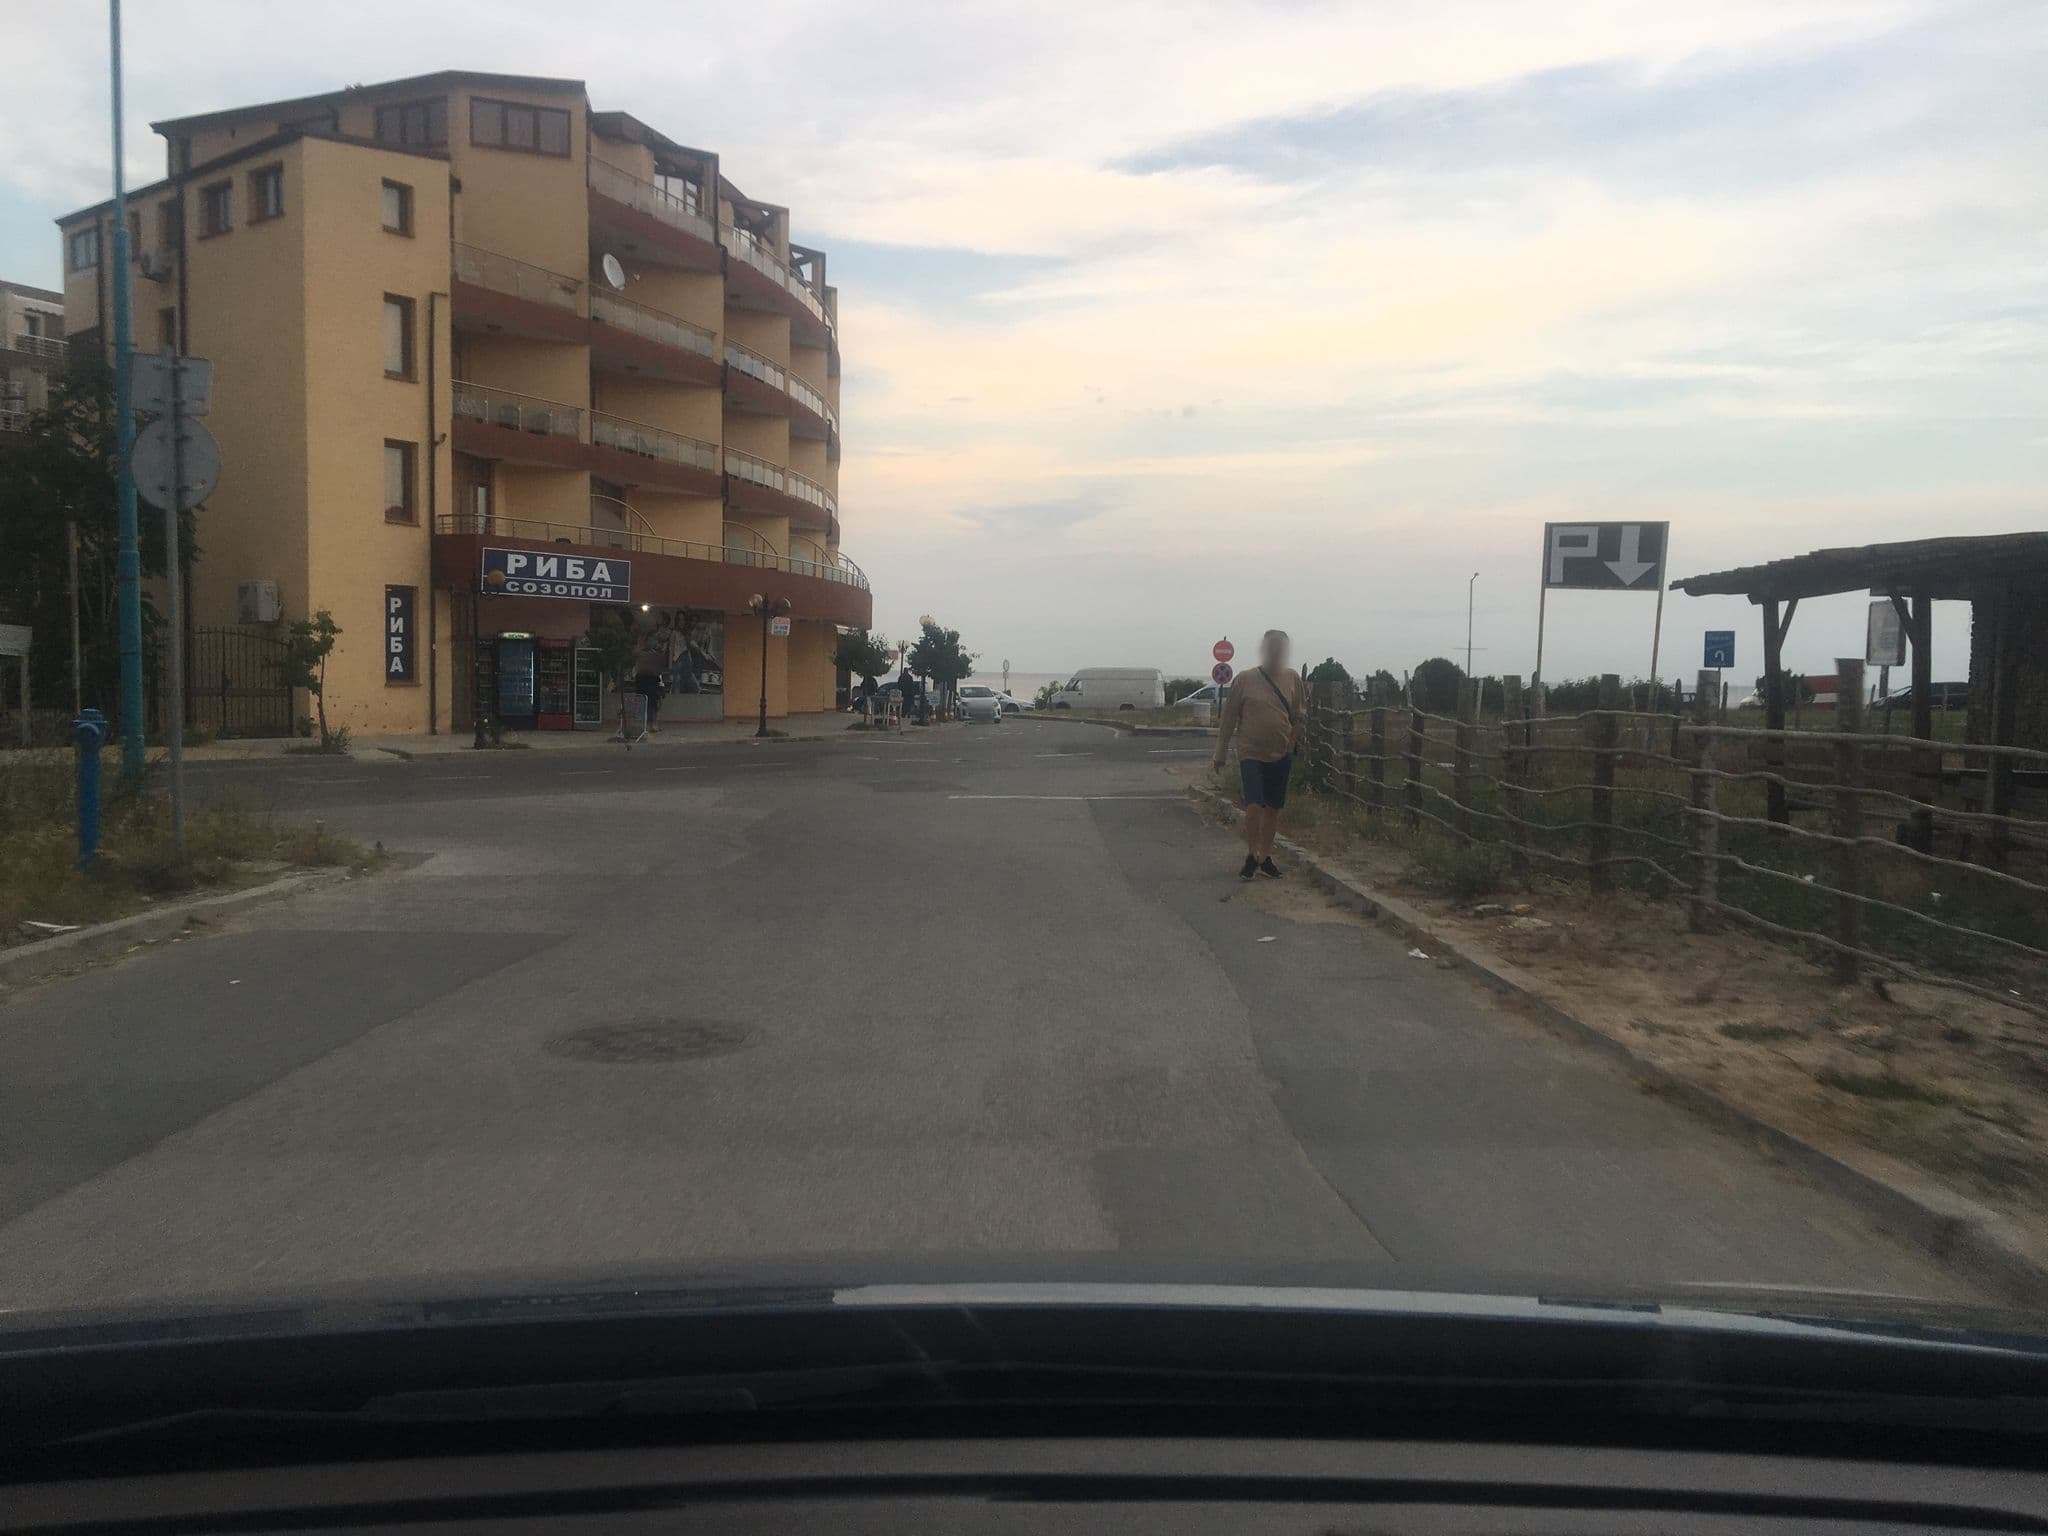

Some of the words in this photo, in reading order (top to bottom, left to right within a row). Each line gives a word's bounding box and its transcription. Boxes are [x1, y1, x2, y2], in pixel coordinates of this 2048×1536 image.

[507, 553, 612, 582] РИБА
[1549, 526, 1599, 583] P
[505, 581, 612, 598] СОЗОПОЛ
[390, 597, 404, 673] РИБА
